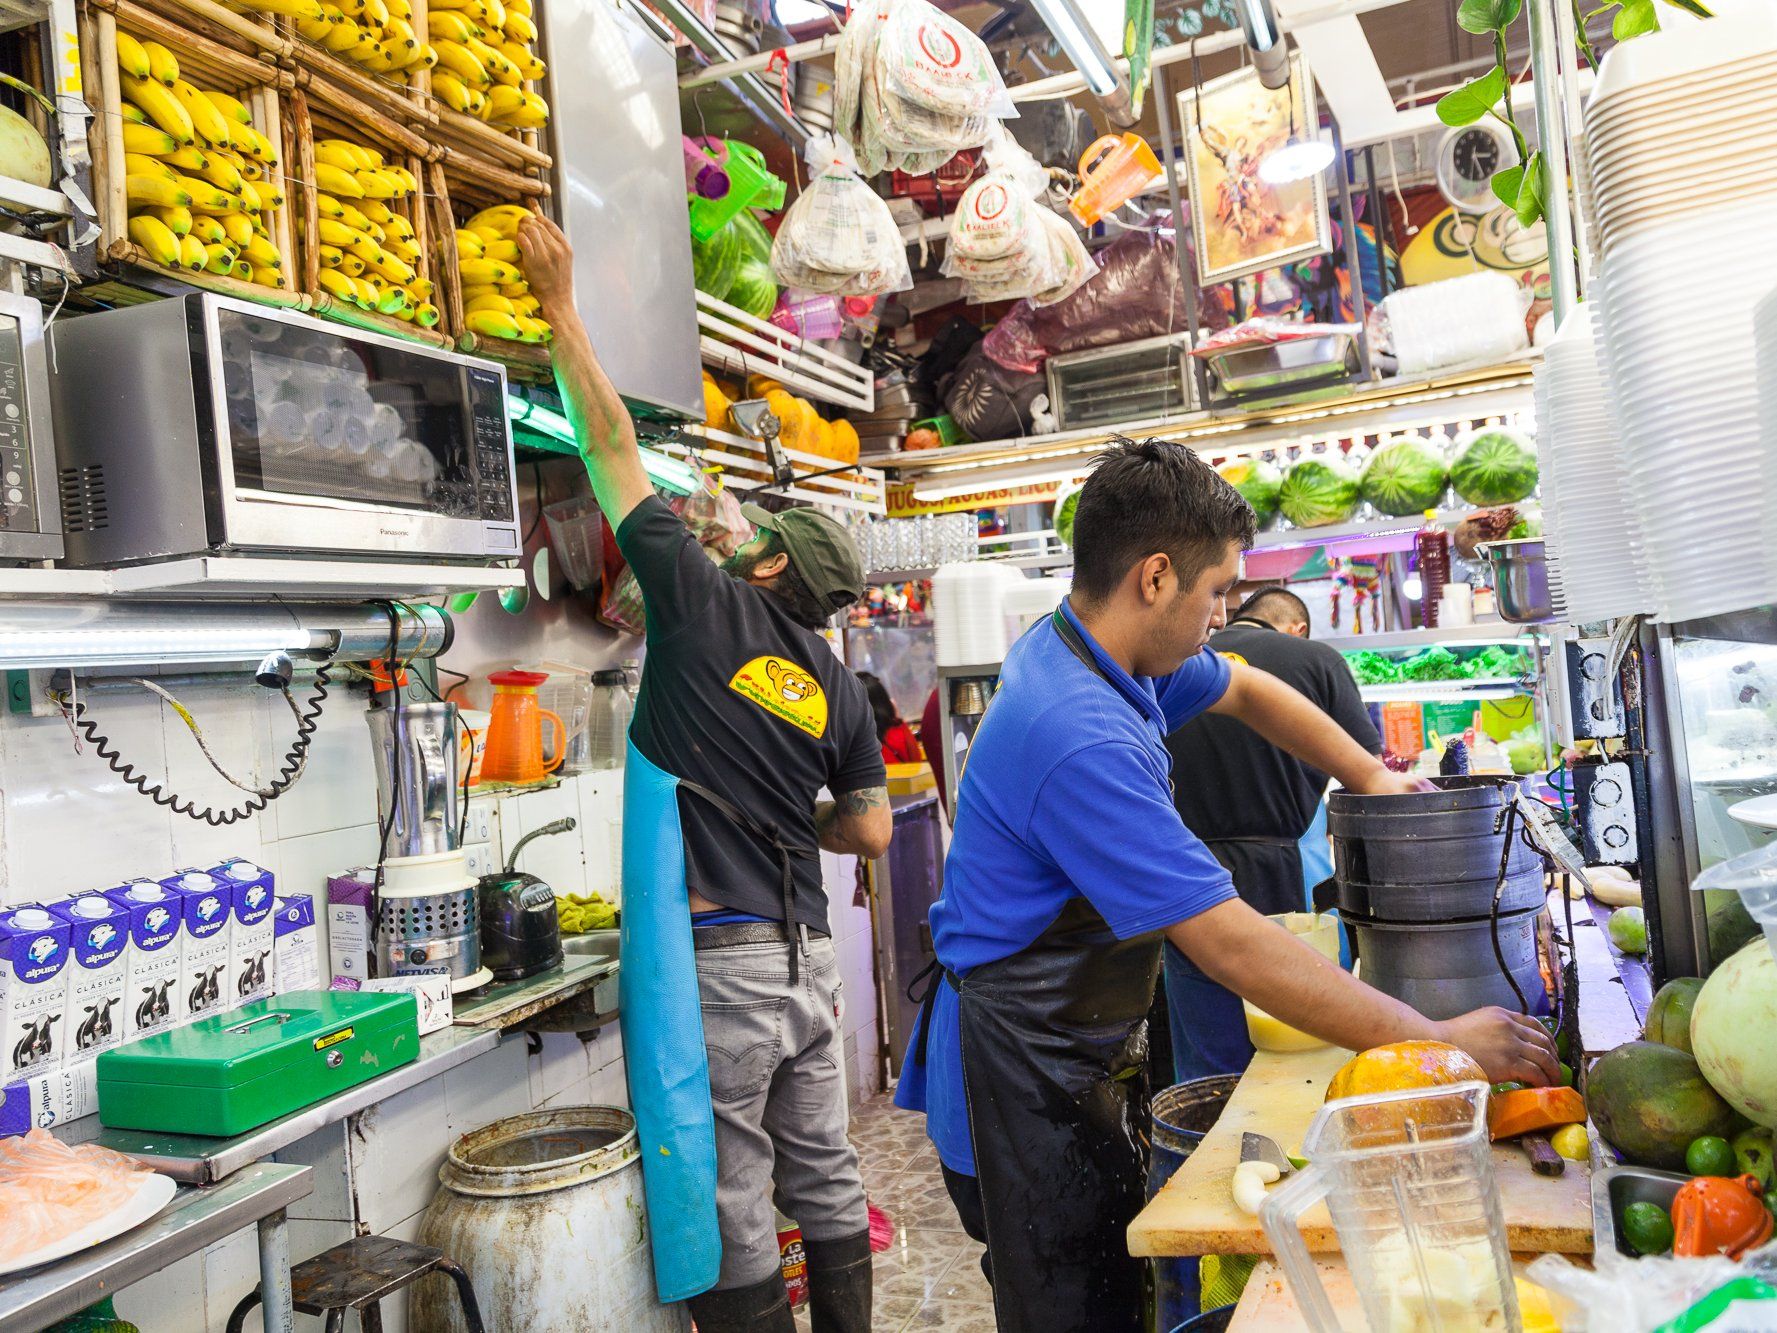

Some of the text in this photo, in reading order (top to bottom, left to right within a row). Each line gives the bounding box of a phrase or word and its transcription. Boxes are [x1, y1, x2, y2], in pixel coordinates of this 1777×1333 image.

[379, 528, 409, 537] Panasonic
[244, 909, 268, 921] alpura
[195, 922, 222, 934] alpura
[142, 934, 171, 946] alpura
[86, 951, 117, 964] alpura
[25, 965, 58, 979] alpura
[41, 1080, 51, 1110] alpura
[788, 1243, 802, 1254] La
